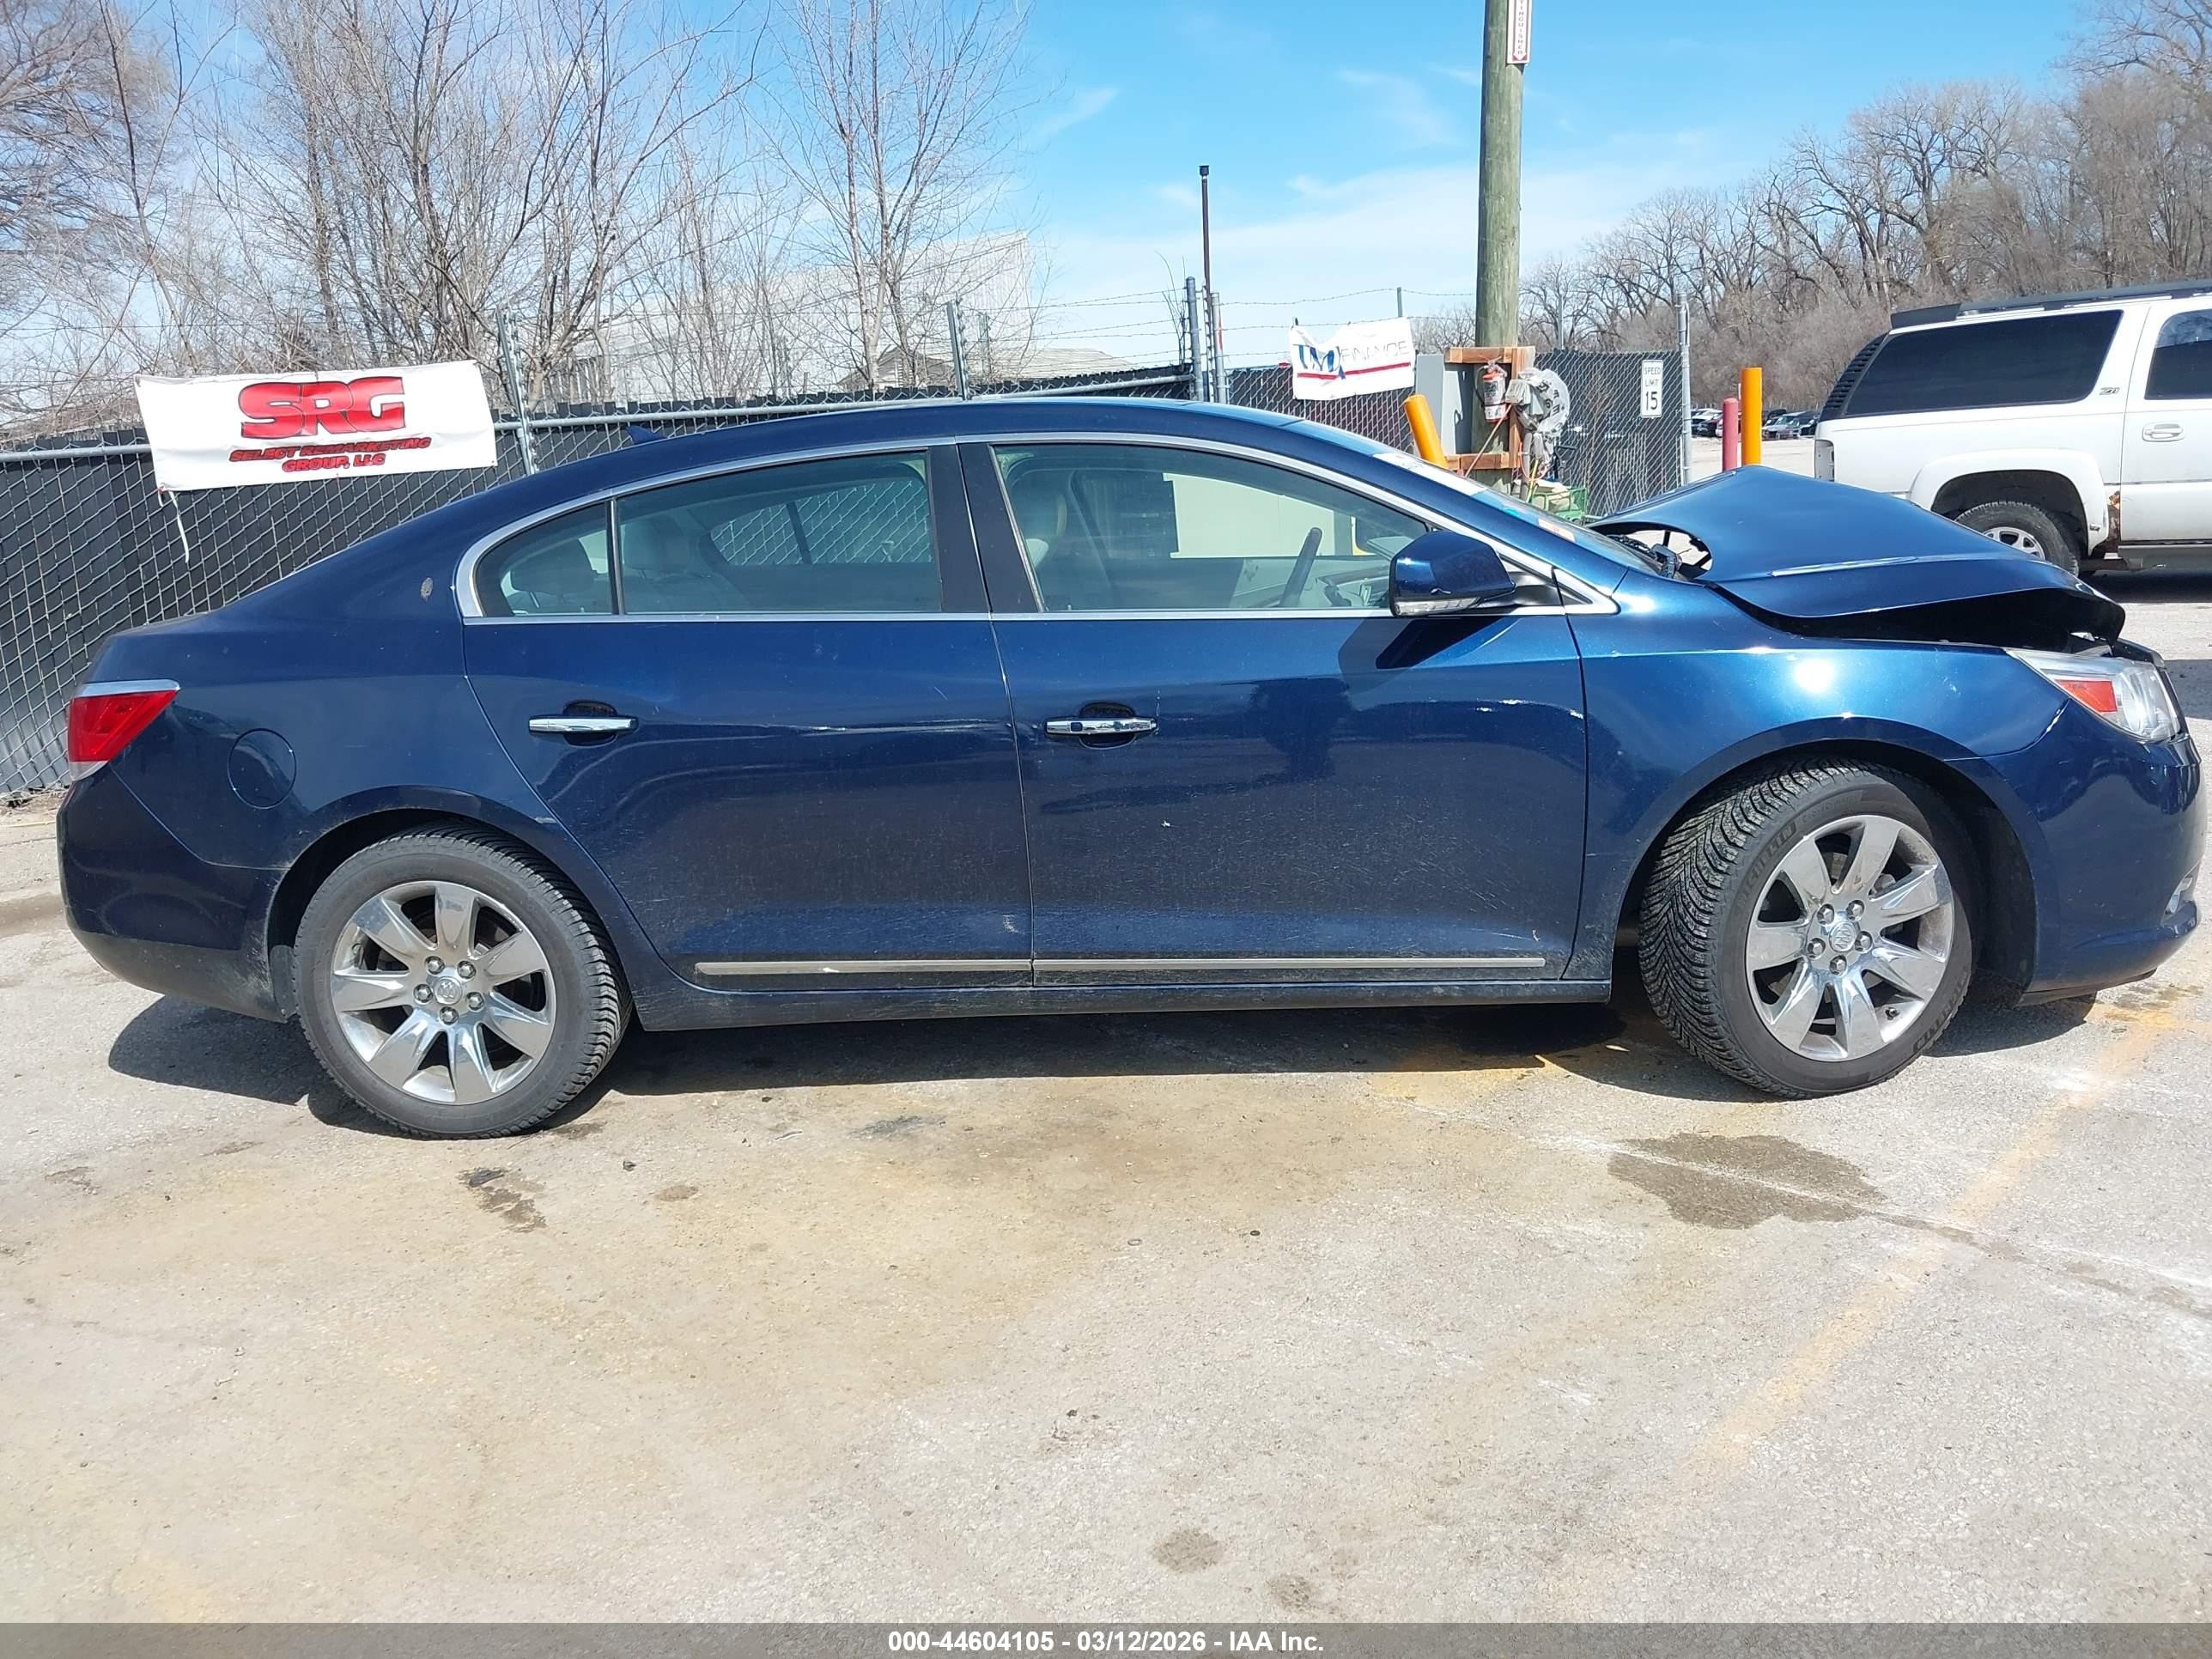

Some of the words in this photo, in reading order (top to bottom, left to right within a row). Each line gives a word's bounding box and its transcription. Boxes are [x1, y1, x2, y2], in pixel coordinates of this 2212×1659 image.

[1644, 367, 1661, 375] SPEED
[1644, 379, 1659, 387] LIMIT
[238, 376, 405, 440] SRG
[1645, 391, 1658, 411] 15
[229, 446, 301, 462] SELECT
[300, 436, 432, 456] REMARKETING
[282, 455, 350, 472] GROUP,
[353, 453, 386, 467] LLC
